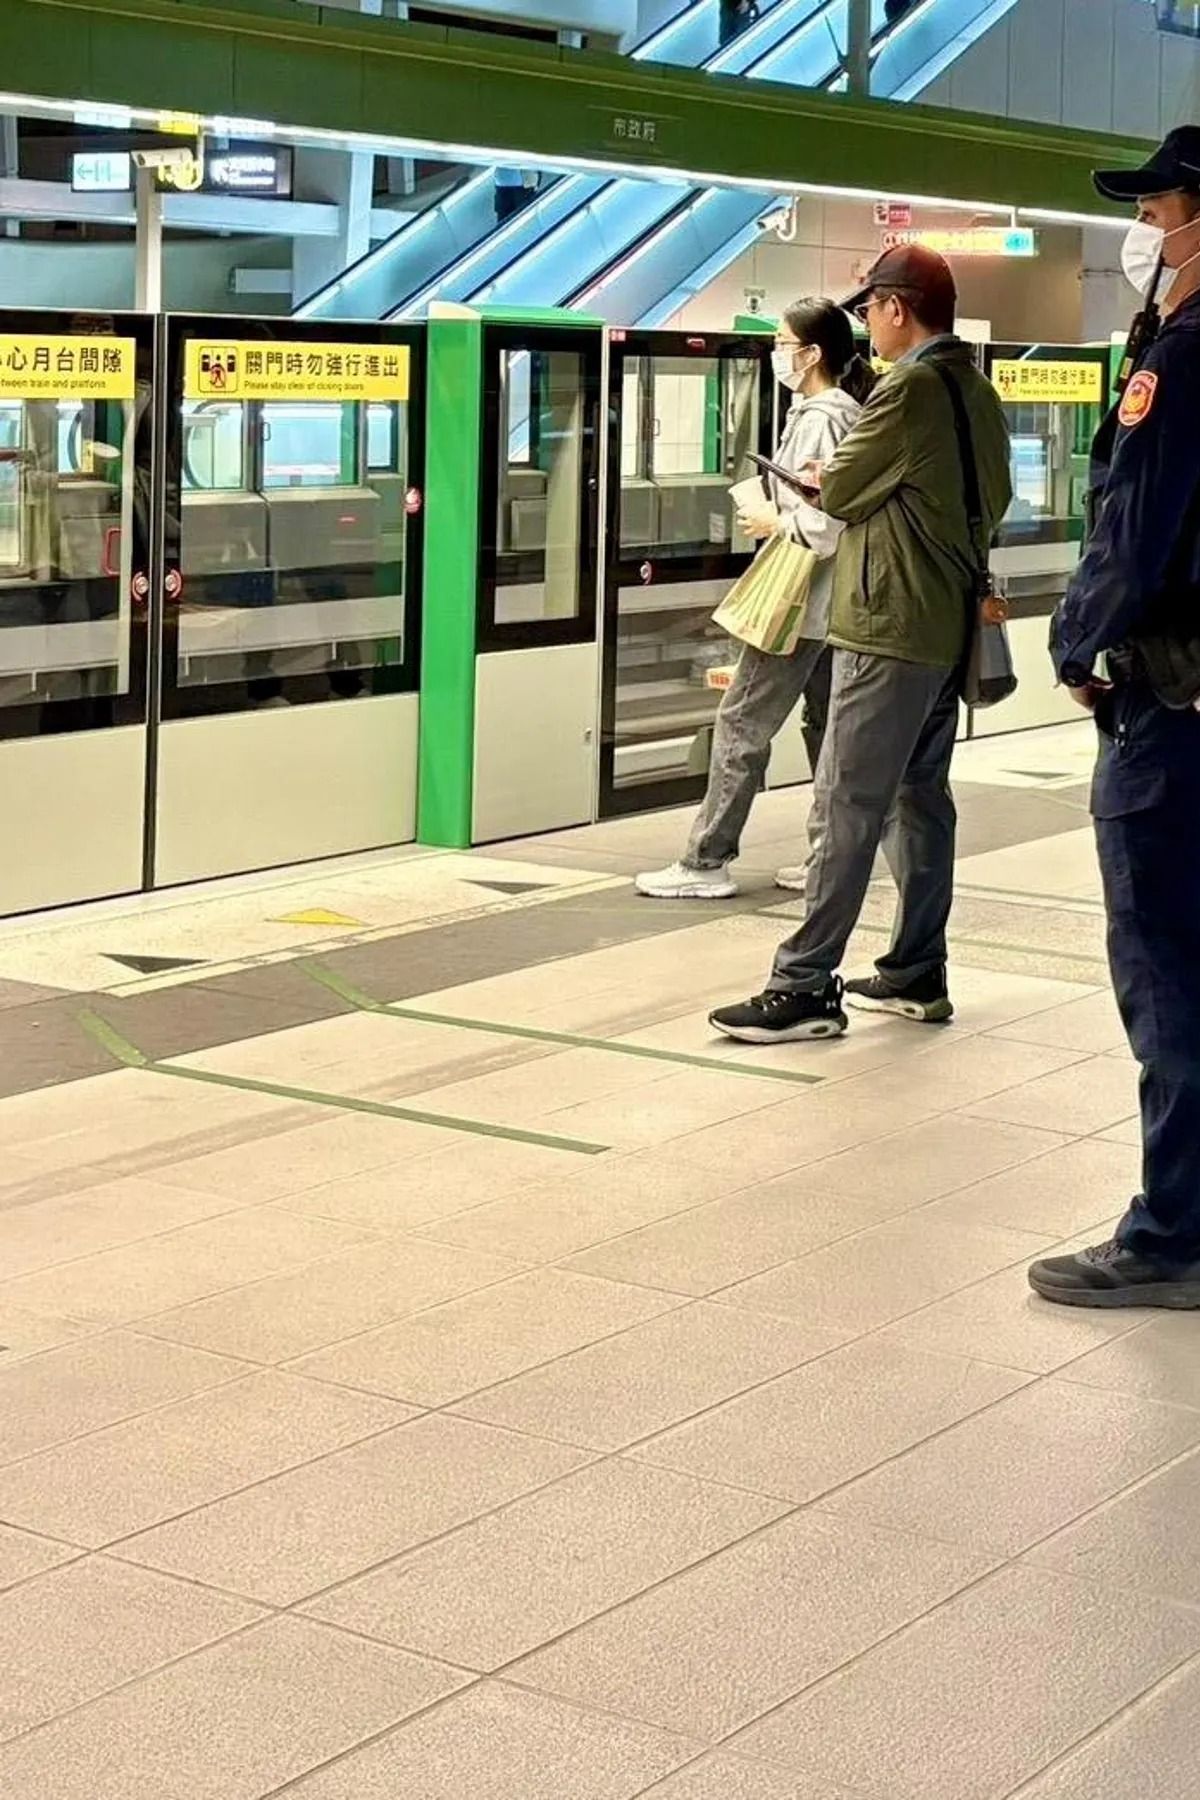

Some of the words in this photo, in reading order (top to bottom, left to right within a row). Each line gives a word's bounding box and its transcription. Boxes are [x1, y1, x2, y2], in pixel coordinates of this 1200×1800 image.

[0, 346, 122, 373] 心月台間隙
[245, 350, 399, 377] 關門時勿強行進出
